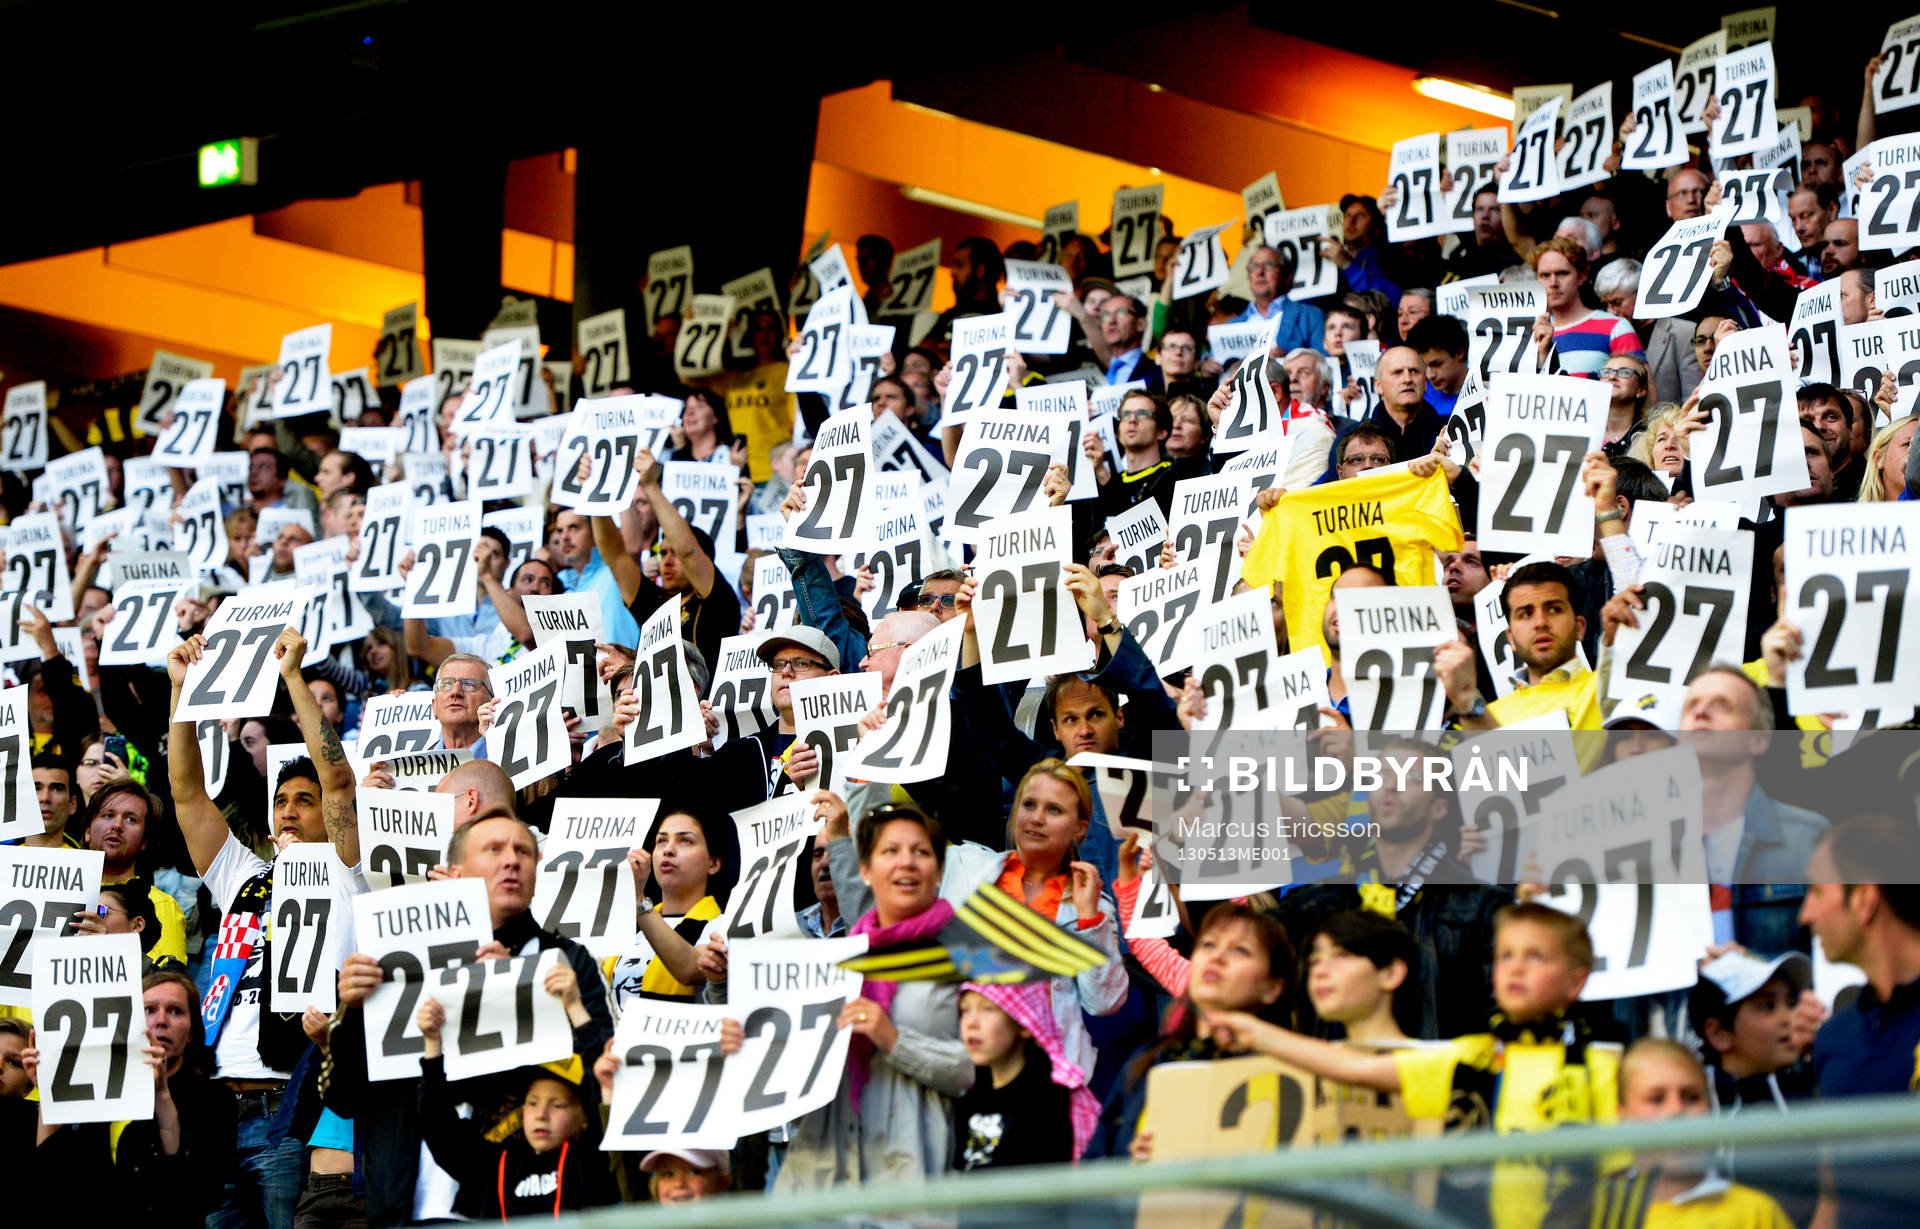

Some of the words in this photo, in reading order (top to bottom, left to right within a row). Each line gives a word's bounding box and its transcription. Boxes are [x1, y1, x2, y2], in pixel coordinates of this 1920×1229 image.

[1728, 18, 1768, 39] TURINA
[1725, 57, 1766, 80] TURINA
[1633, 97, 1673, 158] 27
[1721, 79, 1768, 145] 27
[1457, 139, 1499, 158] TURINA
[1509, 128, 1548, 190] 27
[1564, 116, 1605, 179] 27
[1760, 138, 1793, 166] TURINA
[1394, 168, 1432, 228] 27
[1117, 212, 1157, 265] 27
[1274, 214, 1318, 234] TURINA
[1674, 219, 1721, 240] TURINA
[1181, 237, 1216, 288] 27
[1645, 237, 1715, 304] 27
[651, 275, 687, 326] 27
[887, 266, 934, 309] 27
[1480, 292, 1536, 309] TURINA
[1799, 293, 1832, 321] TURINA
[963, 324, 1006, 345] TURINA
[1014, 289, 1062, 341] 27
[383, 329, 415, 377] 27
[586, 341, 621, 393] 27
[681, 324, 722, 368] 27
[798, 323, 841, 380] 27
[1476, 316, 1536, 381] 27
[1709, 345, 1774, 381] URINA
[1792, 319, 1841, 390] 27
[1852, 335, 1884, 358] TUR
[283, 355, 321, 404] 27
[464, 373, 511, 421] 27
[952, 347, 1007, 413] 27
[1226, 354, 1267, 440] 27
[595, 408, 635, 430] TURINA
[1506, 393, 1589, 423] TURINA
[8, 413, 40, 459] 27
[164, 411, 211, 454] 27
[817, 422, 861, 451] TURINA
[980, 422, 1050, 444] TURINA
[1698, 380, 1783, 487] 27
[475, 437, 520, 488] 27
[588, 435, 638, 502] 27
[675, 473, 727, 491] TURINA
[1492, 433, 1590, 534] 27
[795, 453, 866, 539] 27
[955, 447, 1050, 528] 27
[1183, 486, 1239, 515] TURINA
[183, 511, 216, 561] 27
[422, 514, 471, 535] TURINA
[988, 525, 1056, 559] TURINA
[1118, 514, 1161, 549] TURINA
[1312, 502, 1384, 536] TURINA
[1806, 526, 1906, 557] TURINA
[360, 516, 400, 578] 27
[1176, 516, 1239, 604] 27
[1657, 543, 1732, 576] URINA
[10, 550, 57, 608] 27
[121, 562, 181, 581] TURINA
[413, 538, 472, 604] 27
[870, 540, 921, 619] 27
[1132, 567, 1198, 606] TURINA
[111, 590, 177, 652] 27
[225, 601, 295, 623] TURINA
[535, 608, 589, 631] TURINA
[642, 615, 673, 654] TURINA
[982, 561, 1061, 665] 27
[1127, 590, 1200, 665] 27
[1203, 612, 1261, 652] TURINA
[1354, 606, 1440, 634] TURINA
[1626, 581, 1735, 686] 27
[1798, 569, 1910, 689] 27
[189, 624, 286, 706] 27
[505, 655, 556, 697] TURINA
[904, 637, 948, 677] TURINA
[374, 703, 433, 727] TURINA
[633, 645, 684, 748] 27
[801, 690, 868, 721] TURINA
[862, 669, 947, 767] 27
[1202, 651, 1268, 755] 27
[1355, 645, 1437, 750] 27
[494, 679, 558, 778] 27
[370, 807, 437, 837] TURINA
[565, 816, 637, 840] TURINA
[751, 808, 805, 847] TURINA
[1553, 793, 1646, 835] TURINA
[11, 863, 84, 892] TURINA
[283, 861, 330, 887] TURINA
[543, 847, 631, 938] 27
[727, 839, 800, 938] 27
[373, 900, 471, 939] TURINA
[276, 898, 331, 994] 27
[50, 955, 128, 985] TURINA
[750, 962, 846, 991] TURINA
[641, 1015, 722, 1036] TURIN
[43, 996, 133, 1103] 27
[743, 996, 846, 1113] 27
[622, 1042, 726, 1136] 27
